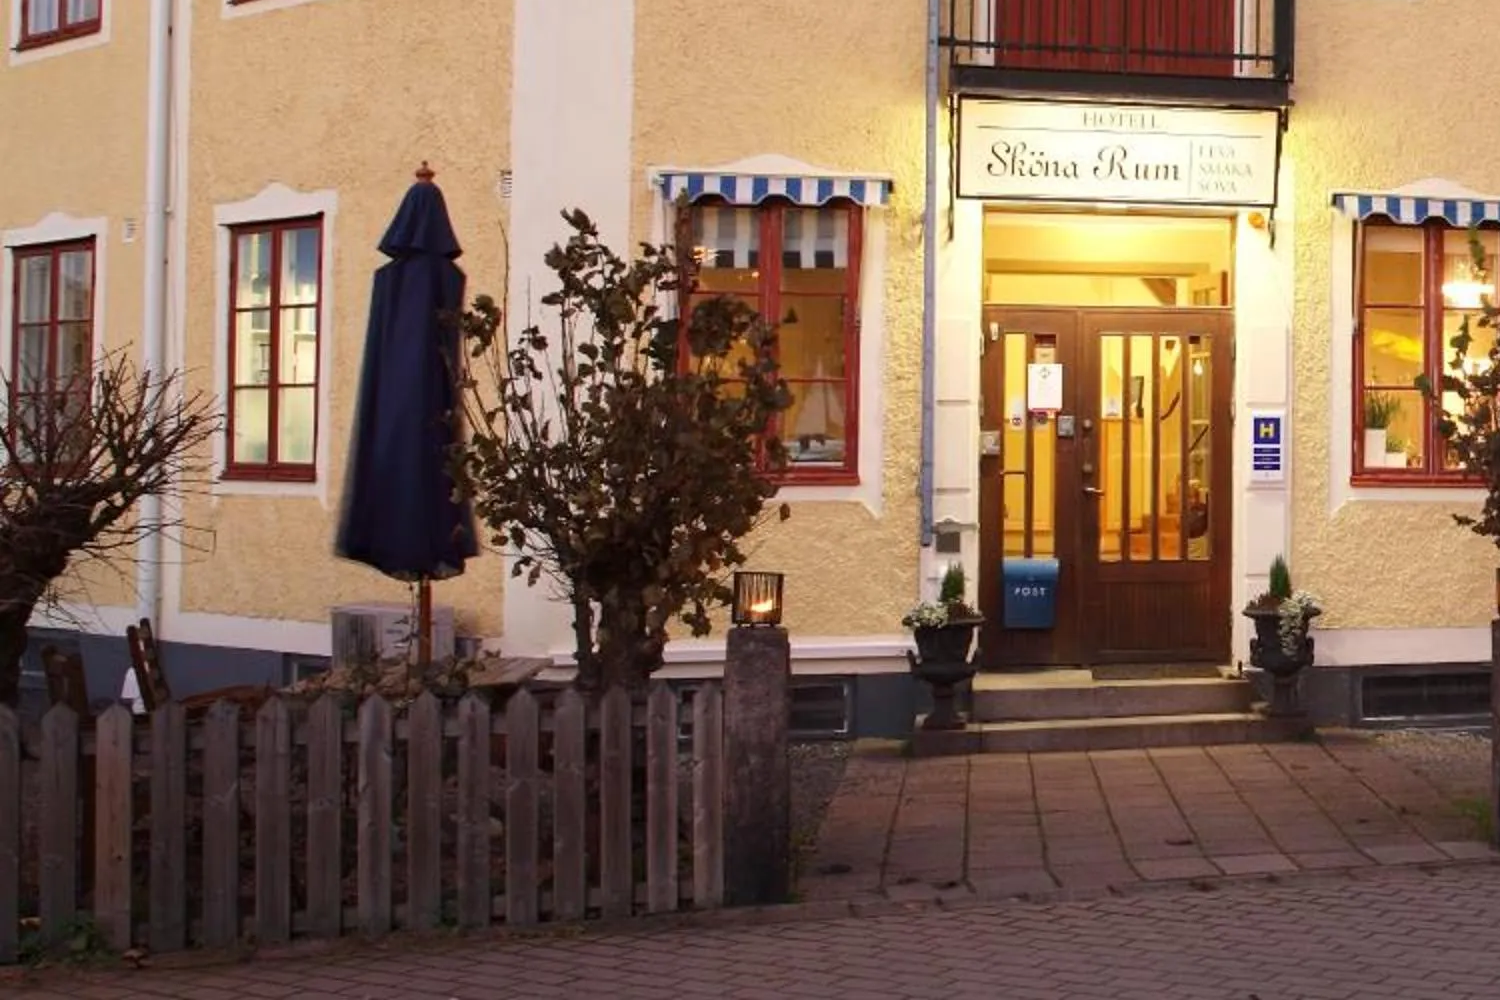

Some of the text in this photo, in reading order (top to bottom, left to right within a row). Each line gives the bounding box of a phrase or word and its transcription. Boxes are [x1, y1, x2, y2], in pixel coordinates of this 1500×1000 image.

[1083, 111, 1161, 129] HOTELL
[987, 141, 1180, 181] Sköna Rum
[1259, 423, 1275, 438] H
[1014, 587, 1046, 597] POST
